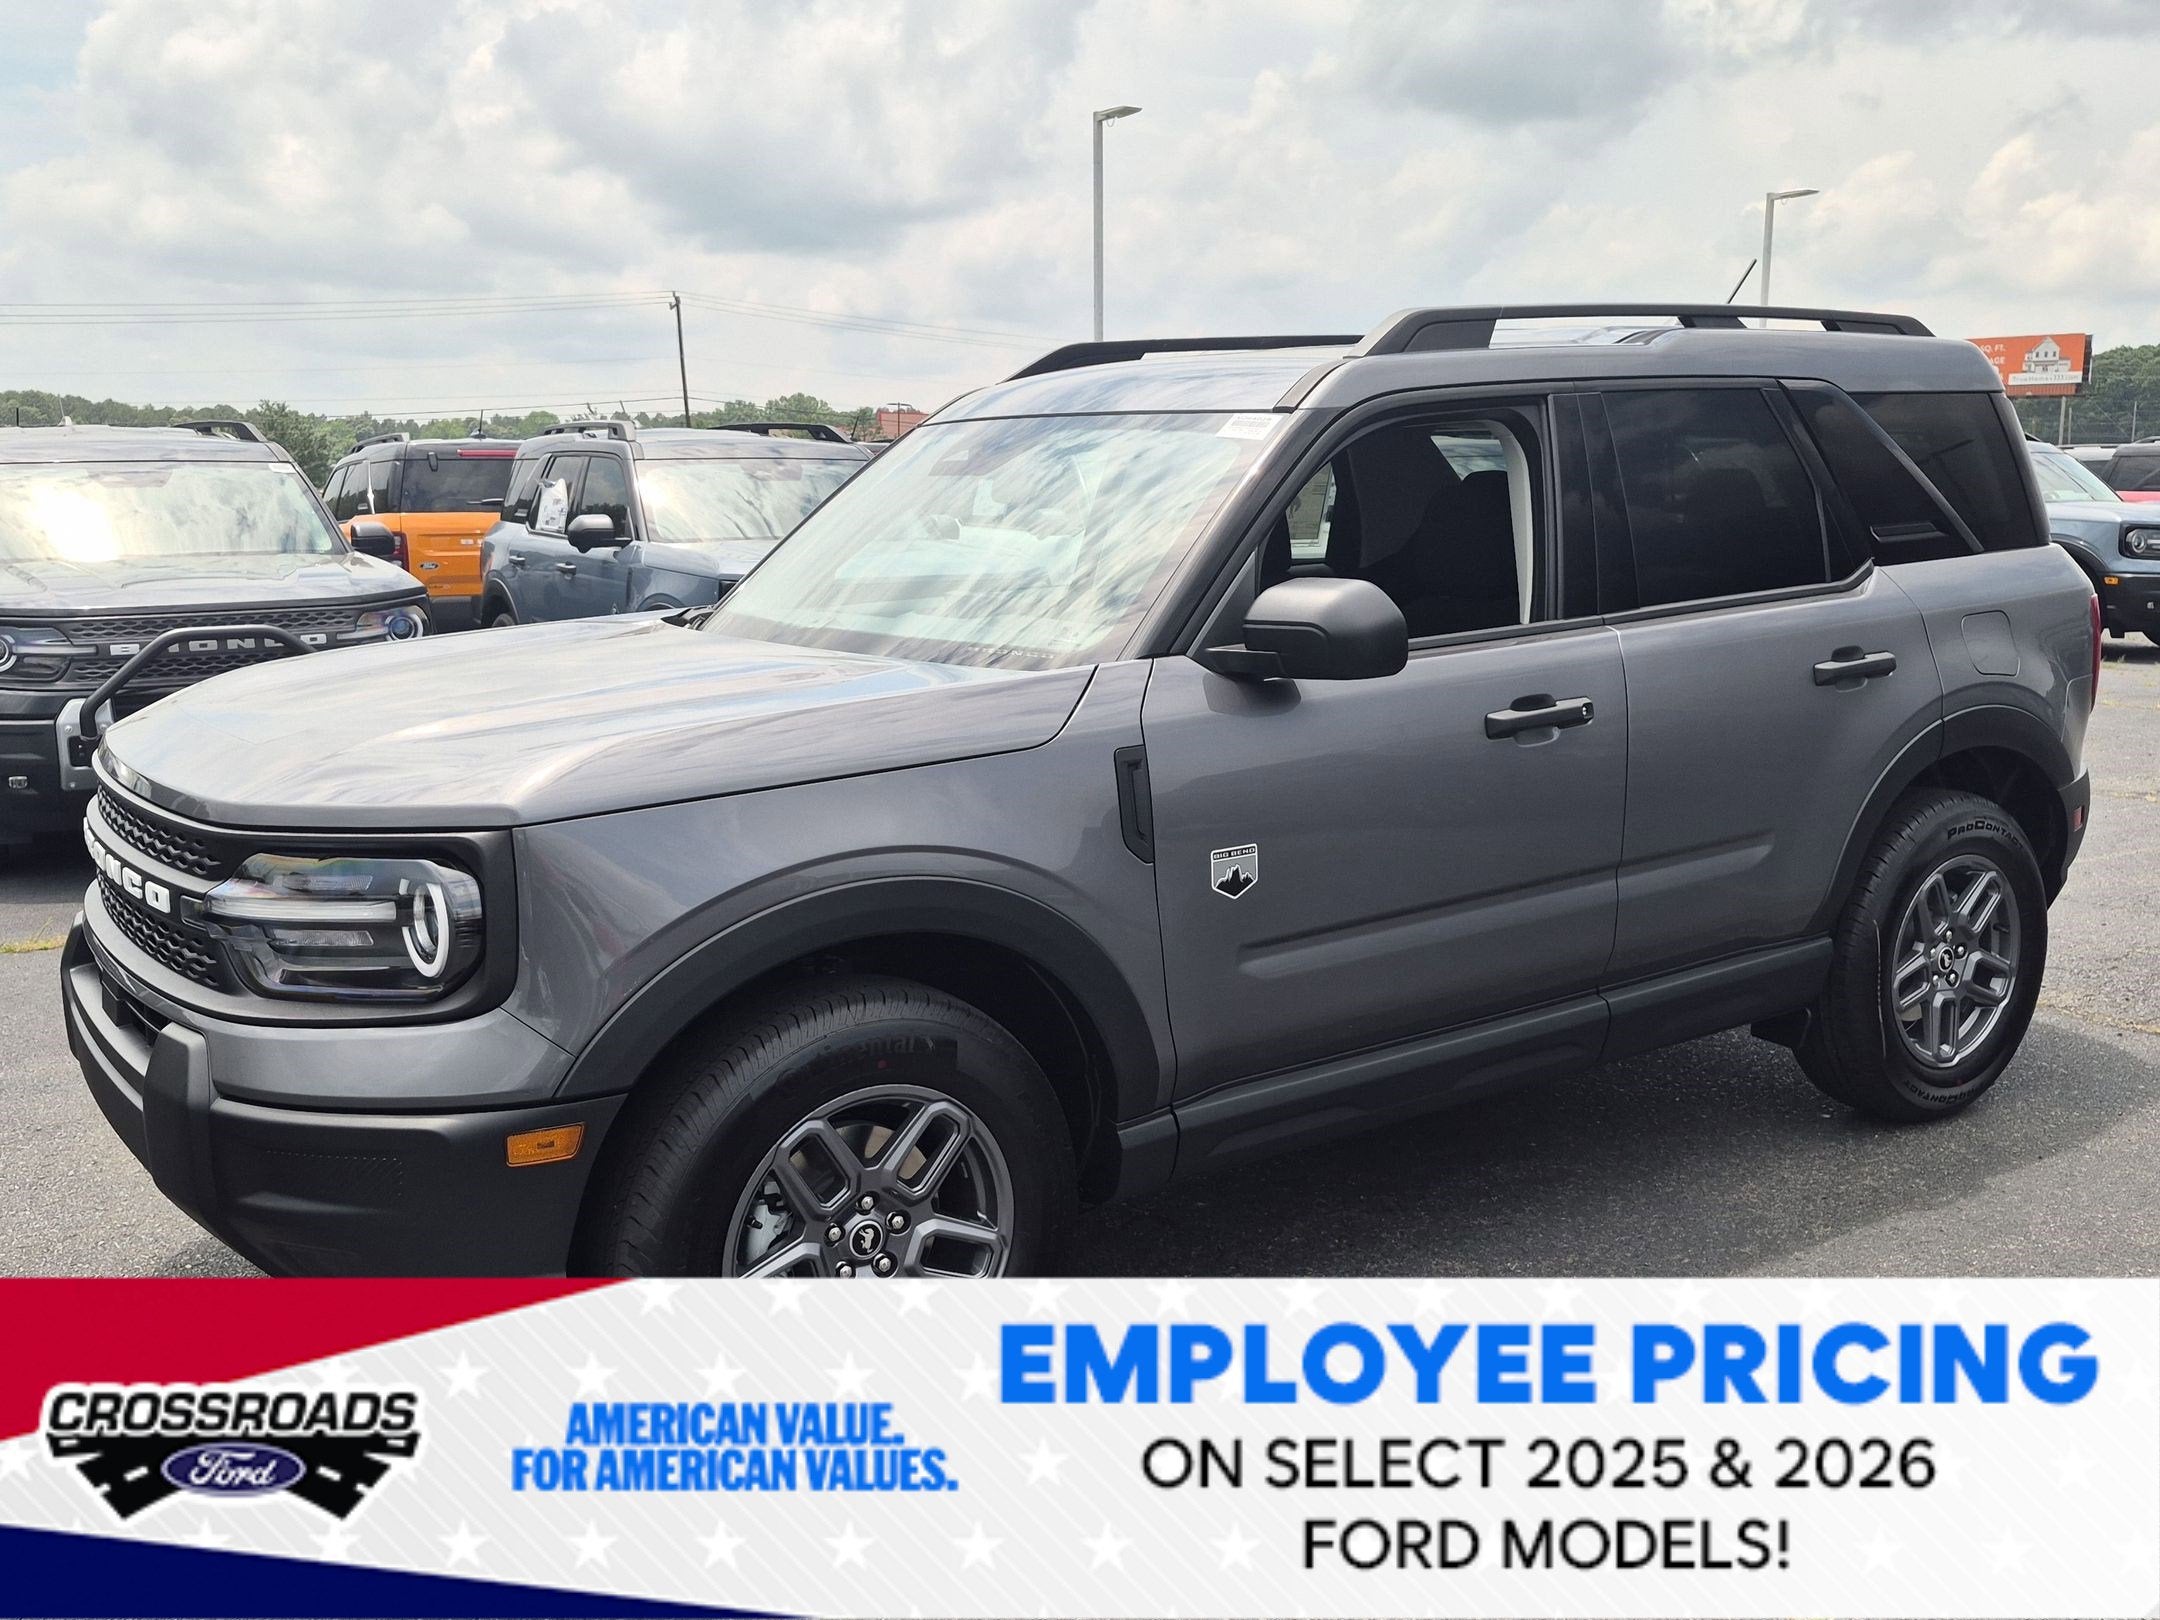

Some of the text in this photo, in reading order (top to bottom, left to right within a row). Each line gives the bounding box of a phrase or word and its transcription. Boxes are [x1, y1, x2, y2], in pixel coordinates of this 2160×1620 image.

[109, 633, 327, 656] BONCO
[83, 816, 171, 914] RONCO
[1213, 847, 1255, 860] BIG BEND
